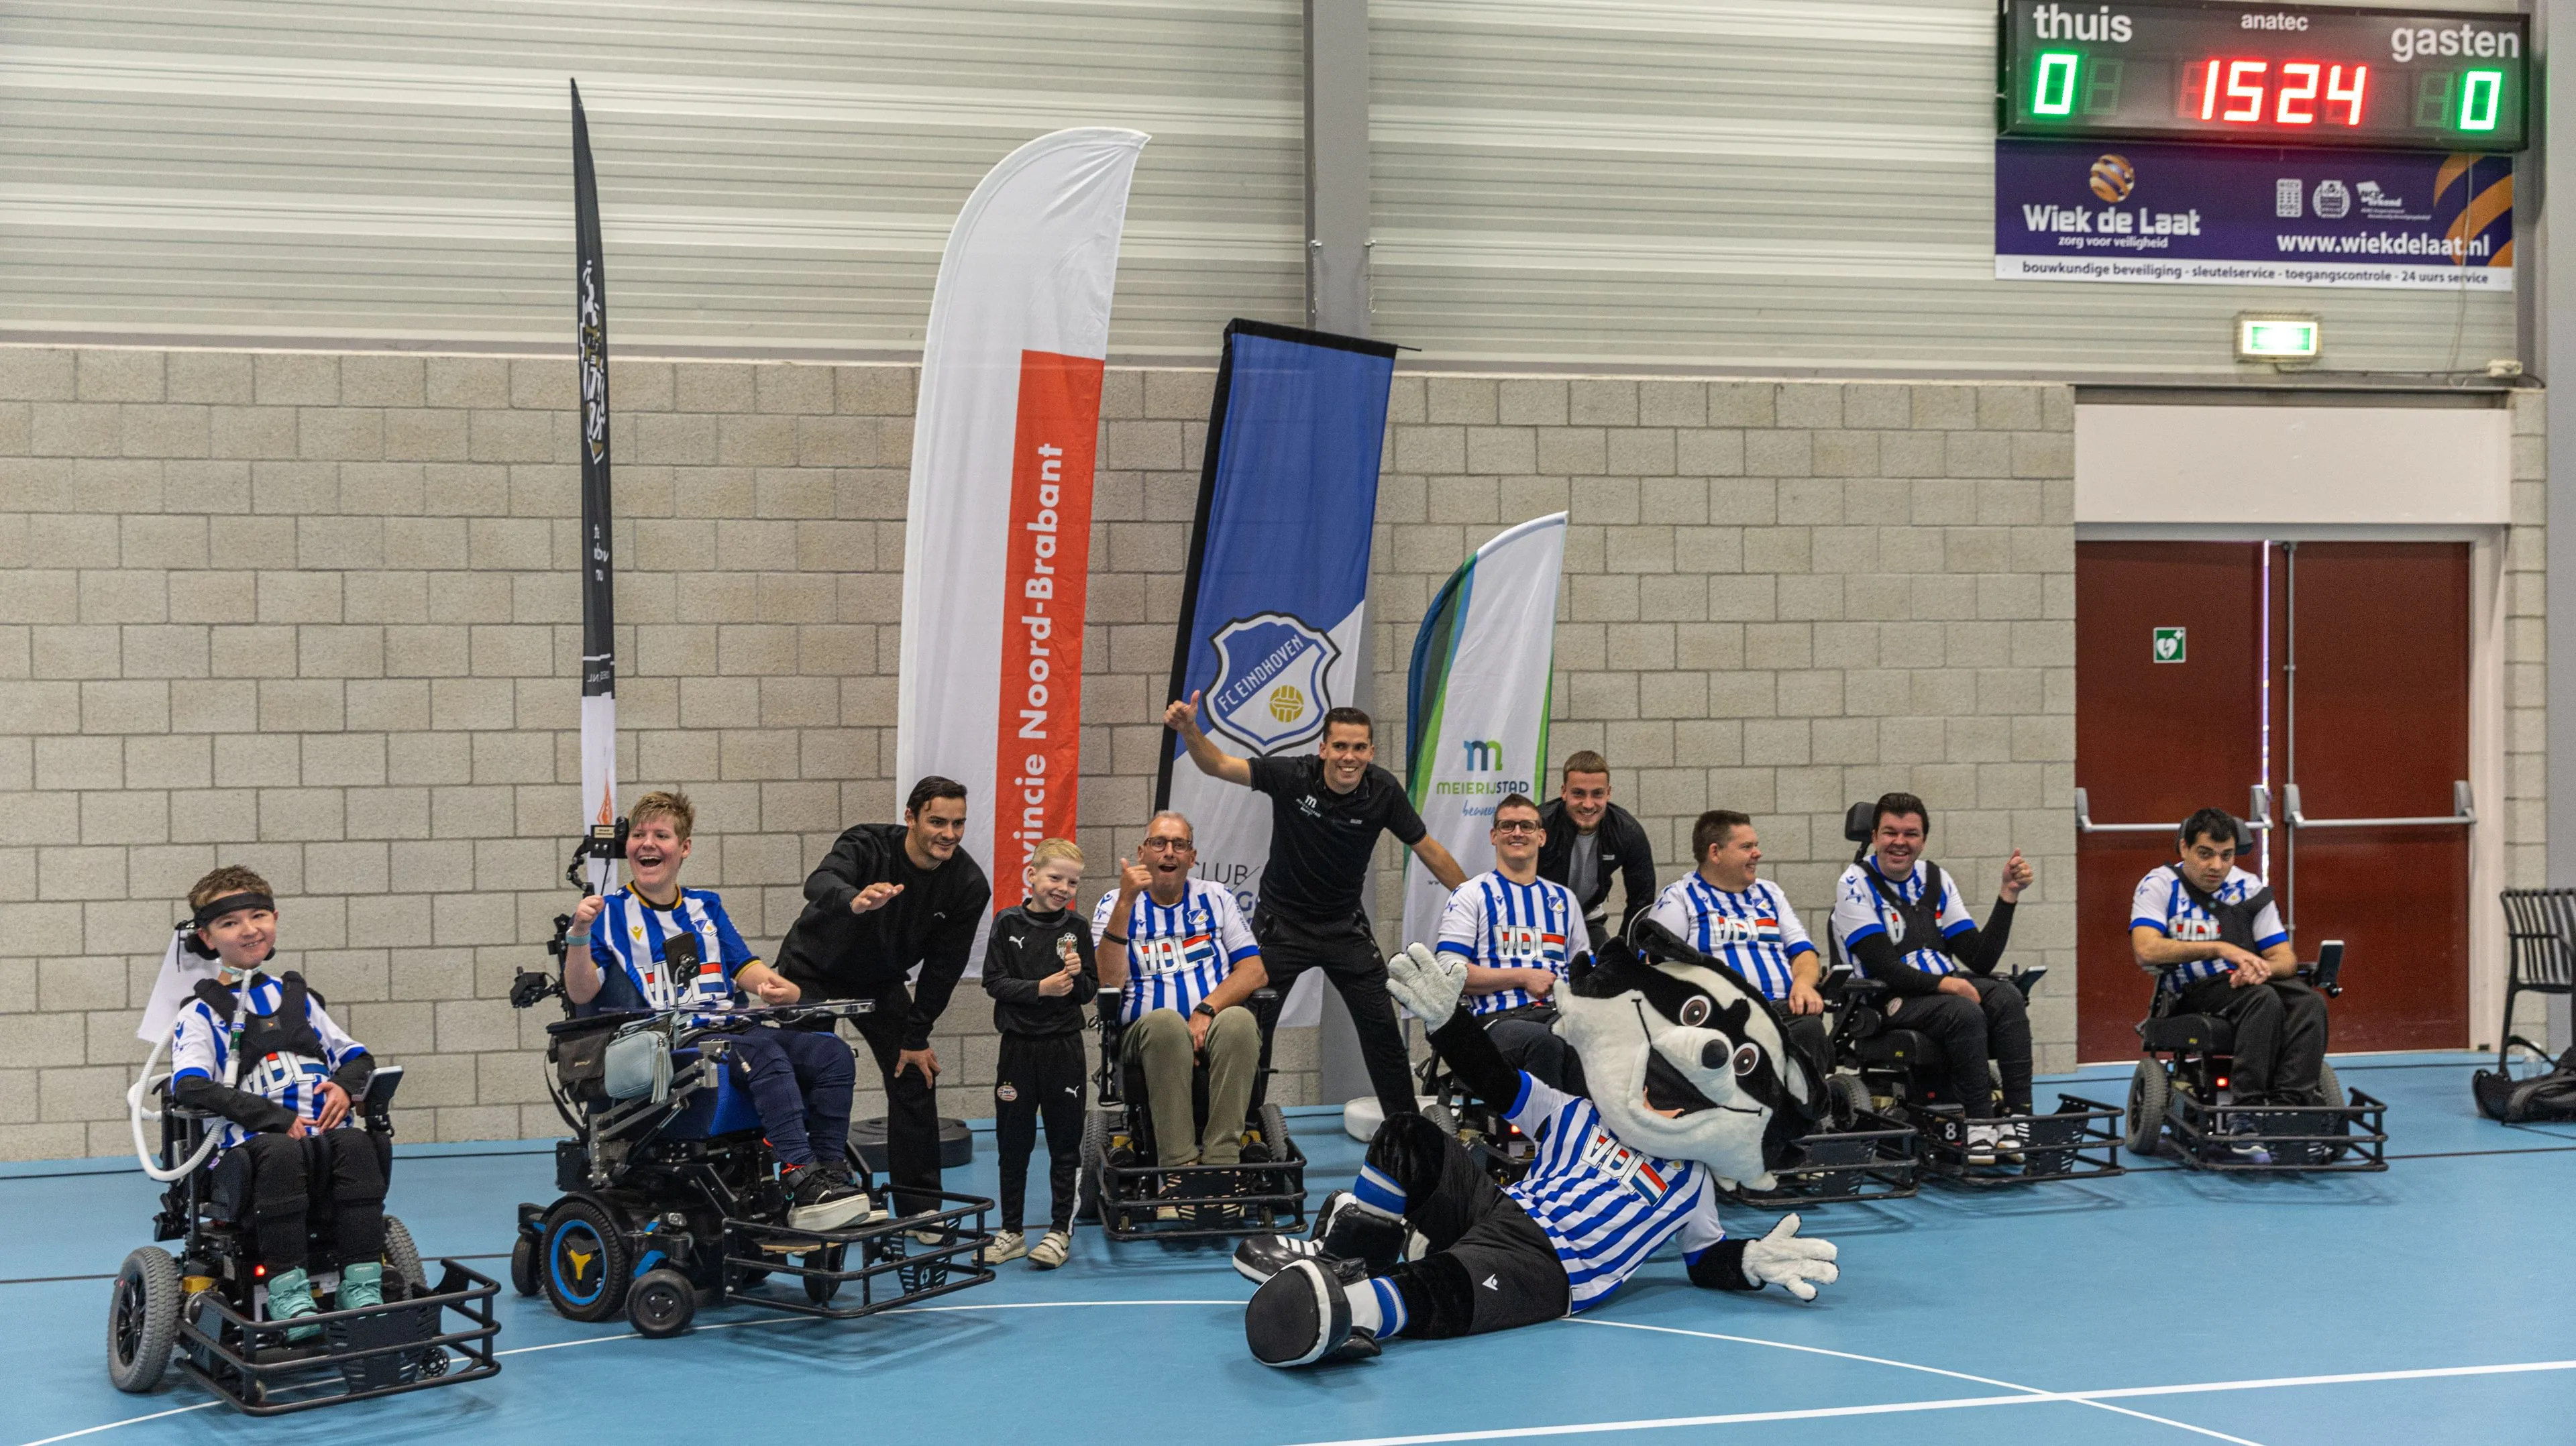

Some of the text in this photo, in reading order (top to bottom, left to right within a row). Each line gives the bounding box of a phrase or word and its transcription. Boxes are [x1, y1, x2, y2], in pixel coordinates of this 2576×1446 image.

[2033, 3, 2133, 42] thuis
[2241, 12, 2309, 31] anatec
[2391, 24, 2519, 62] gasten
[2033, 53, 2078, 115] 0
[2460, 70, 2502, 130] 0
[2023, 205, 2200, 236] Wiek de Laat
[2058, 235, 2168, 250] zorg voor veiligheid
[2277, 231, 2490, 256] www.wiekdelaat.nl
[2023, 261, 2110, 277] bouwkundige
[2113, 263, 2182, 279] beveiliging
[2192, 265, 2275, 279] sleutelservice
[2286, 269, 2392, 283] toegangscontrole
[2402, 272, 2416, 282] 24
[2418, 274, 2445, 282] uurs
[2448, 272, 2488, 284] service
[1019, 443, 1063, 739] Noord-Brabant
[1217, 634, 1305, 712] FC EINDHOVEN
[1436, 781, 1529, 795] MEIERIJSTAD
[1194, 861, 1248, 885] LUB
[1132, 936, 1198, 977] VDL
[1945, 1122, 1957, 1140] 8
